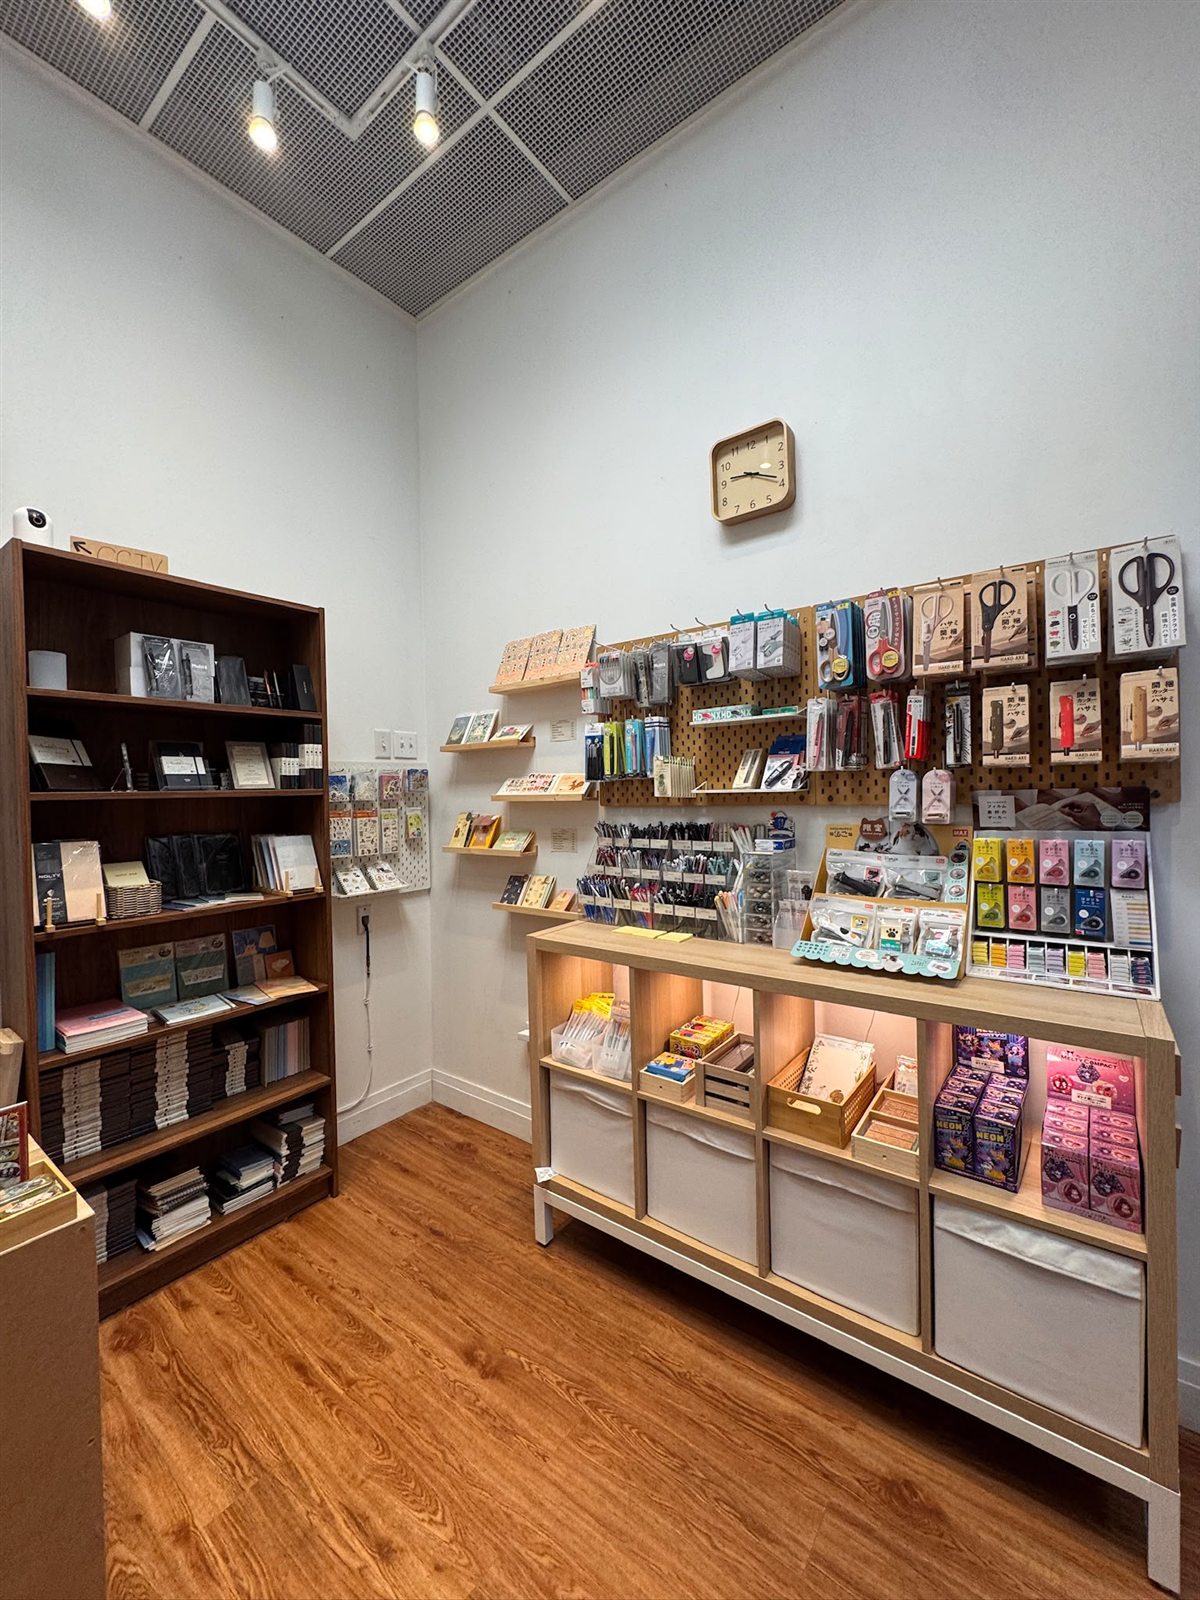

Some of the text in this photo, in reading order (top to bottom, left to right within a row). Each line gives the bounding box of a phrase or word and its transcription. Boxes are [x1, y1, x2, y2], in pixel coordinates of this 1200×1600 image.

[746, 440, 756, 450] 12
[778, 441, 784, 452] 2
[731, 446, 739, 457] 11
[721, 462, 731, 472] 10
[779, 460, 784, 470] 3
[721, 480, 727, 489] 9
[778, 478, 785, 487] 4
[722, 498, 728, 507] 8
[766, 495, 772, 504] 5
[734, 504, 740, 513] 7
[750, 500, 756, 509] 6
[721, 711, 732, 719] HD
[862, 823, 883, 832] 限定
[38, 872, 61, 880] NOLTY
[1061, 1054, 1118, 1069] MELTY COMPACT
[936, 1120, 963, 1131] NEON
[976, 1131, 1004, 1143] NEON
